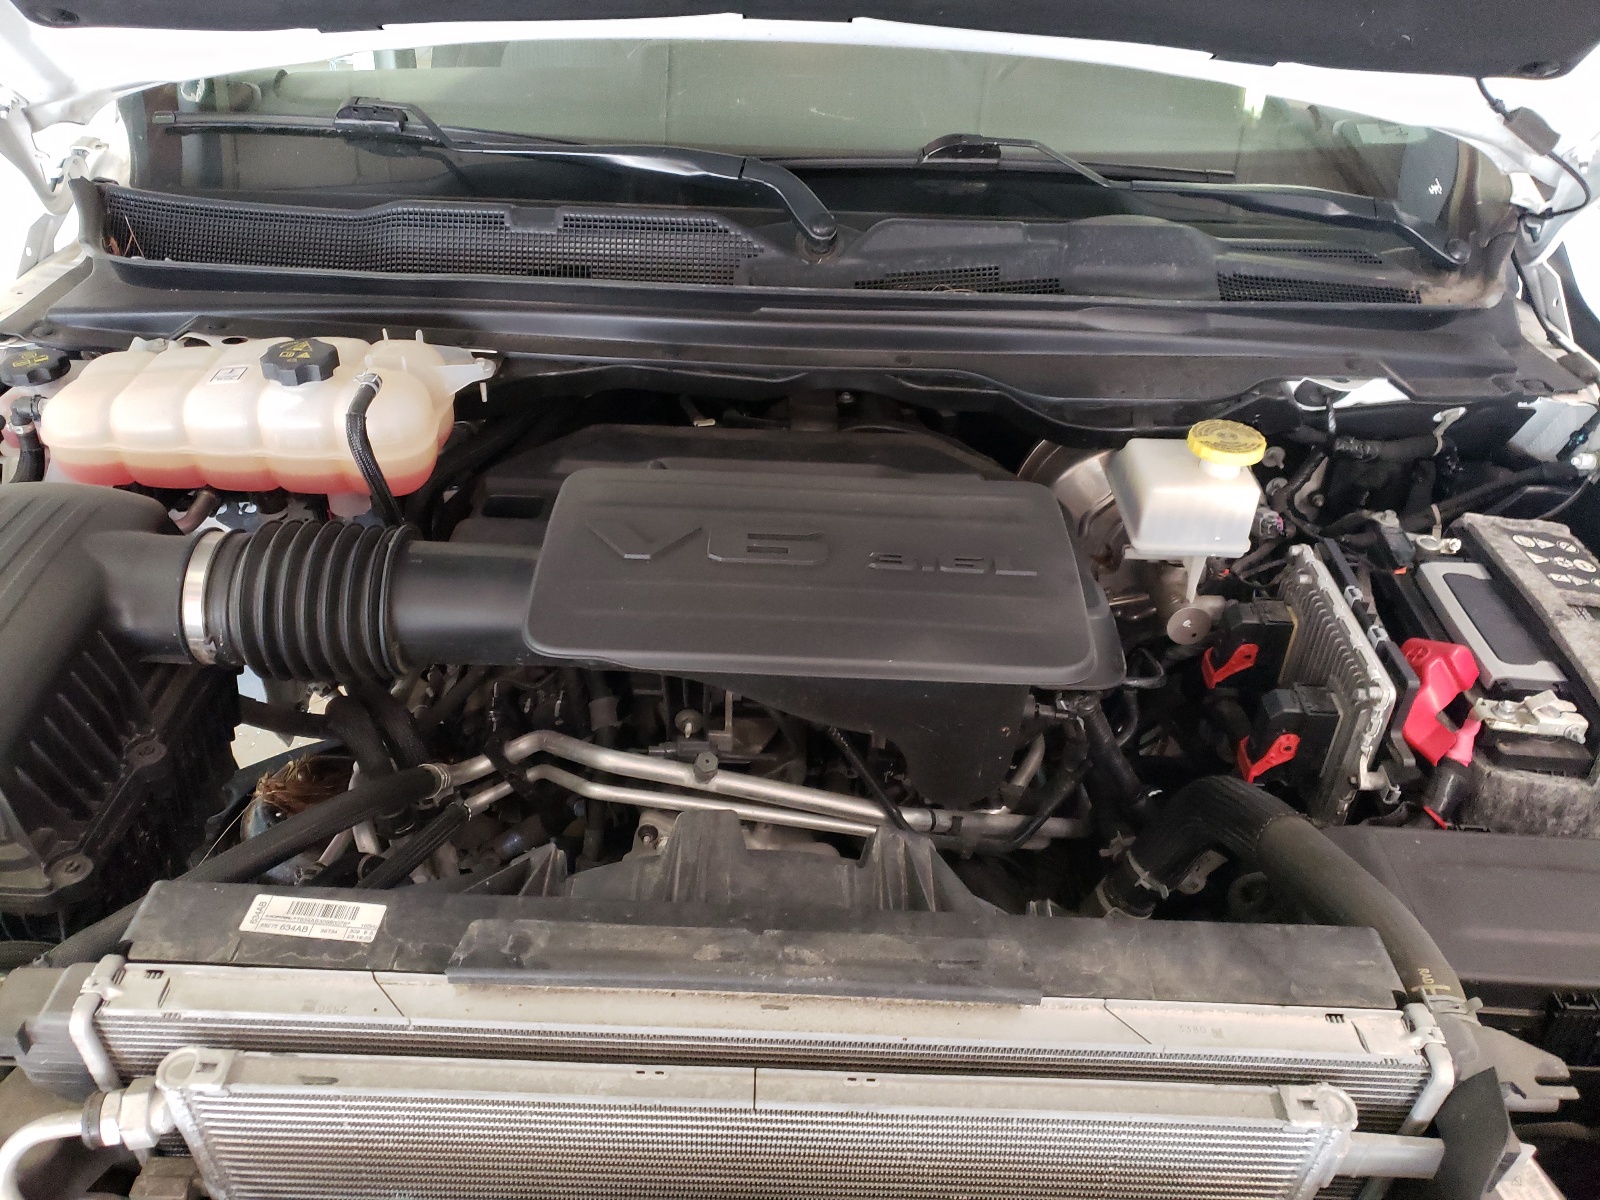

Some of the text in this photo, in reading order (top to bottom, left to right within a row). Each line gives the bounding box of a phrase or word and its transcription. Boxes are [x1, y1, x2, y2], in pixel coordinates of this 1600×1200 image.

[585, 520, 1038, 577] V6 3.6L
[250, 901, 267, 924] 634AB
[279, 923, 309, 933] 634AB
